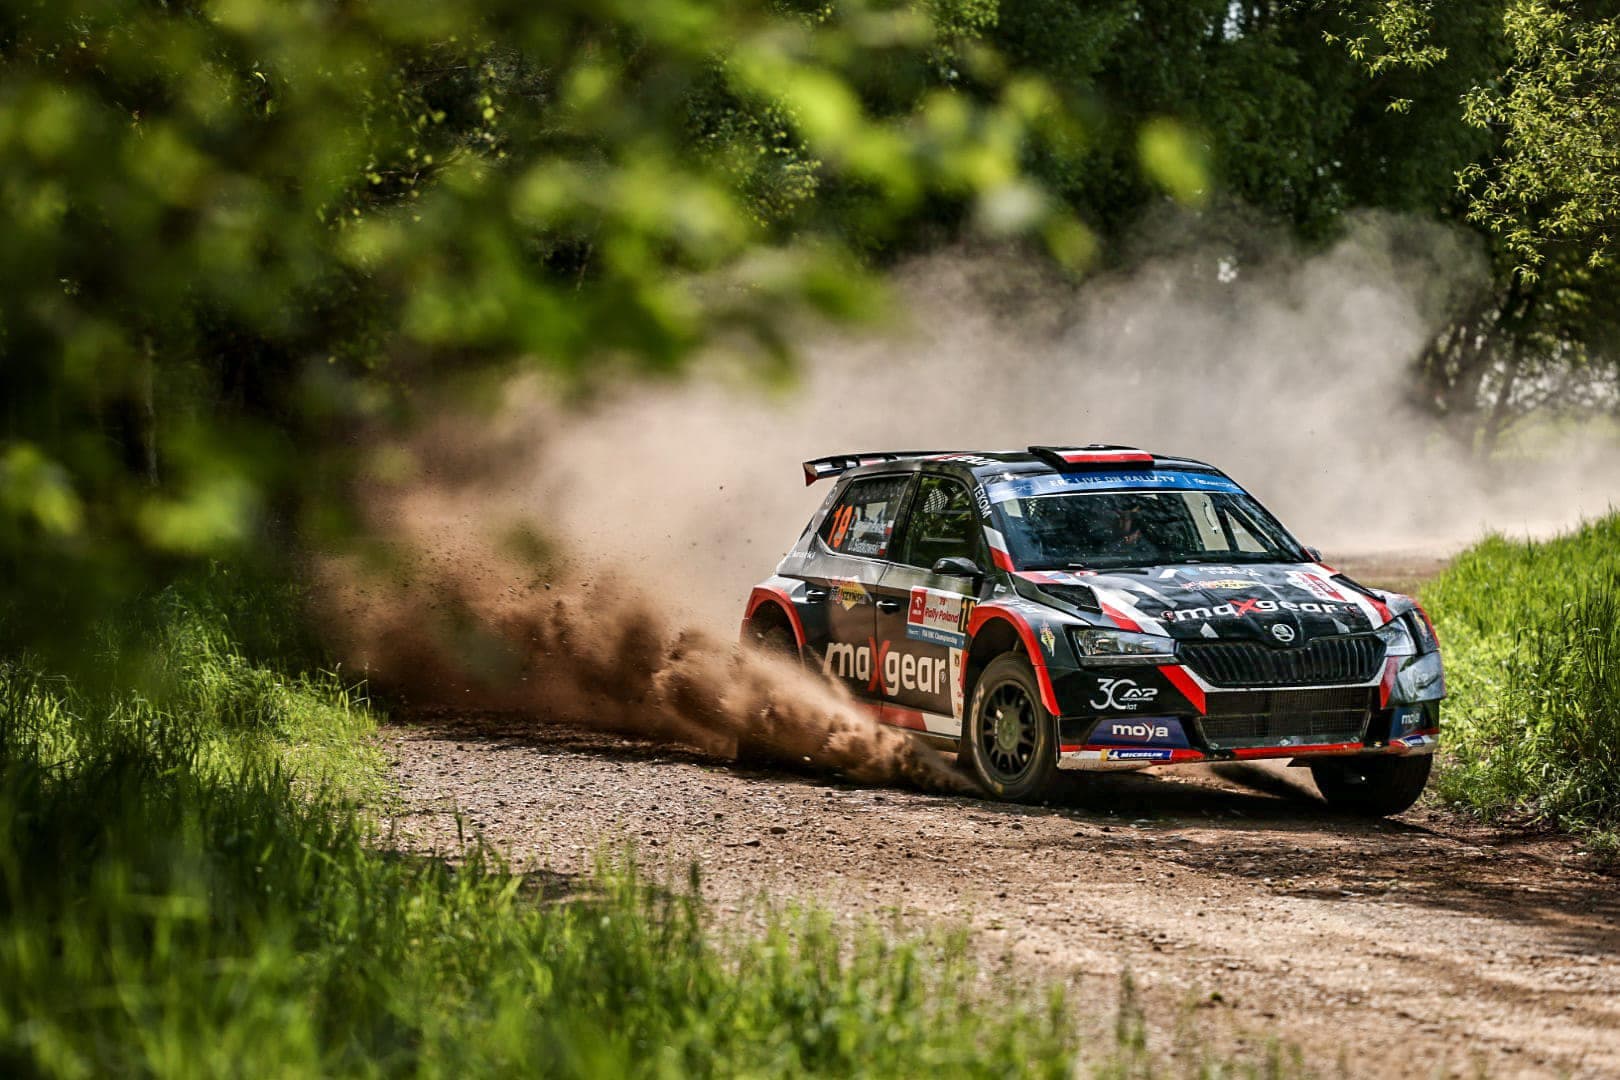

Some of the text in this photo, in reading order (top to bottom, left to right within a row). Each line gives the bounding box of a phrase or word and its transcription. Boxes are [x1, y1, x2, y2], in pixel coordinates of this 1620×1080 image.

[1075, 476, 1101, 485] LIVE
[1124, 474, 1176, 483] RALLY.TV
[925, 607, 938, 622] Rally
[939, 610, 960, 623] Poland
